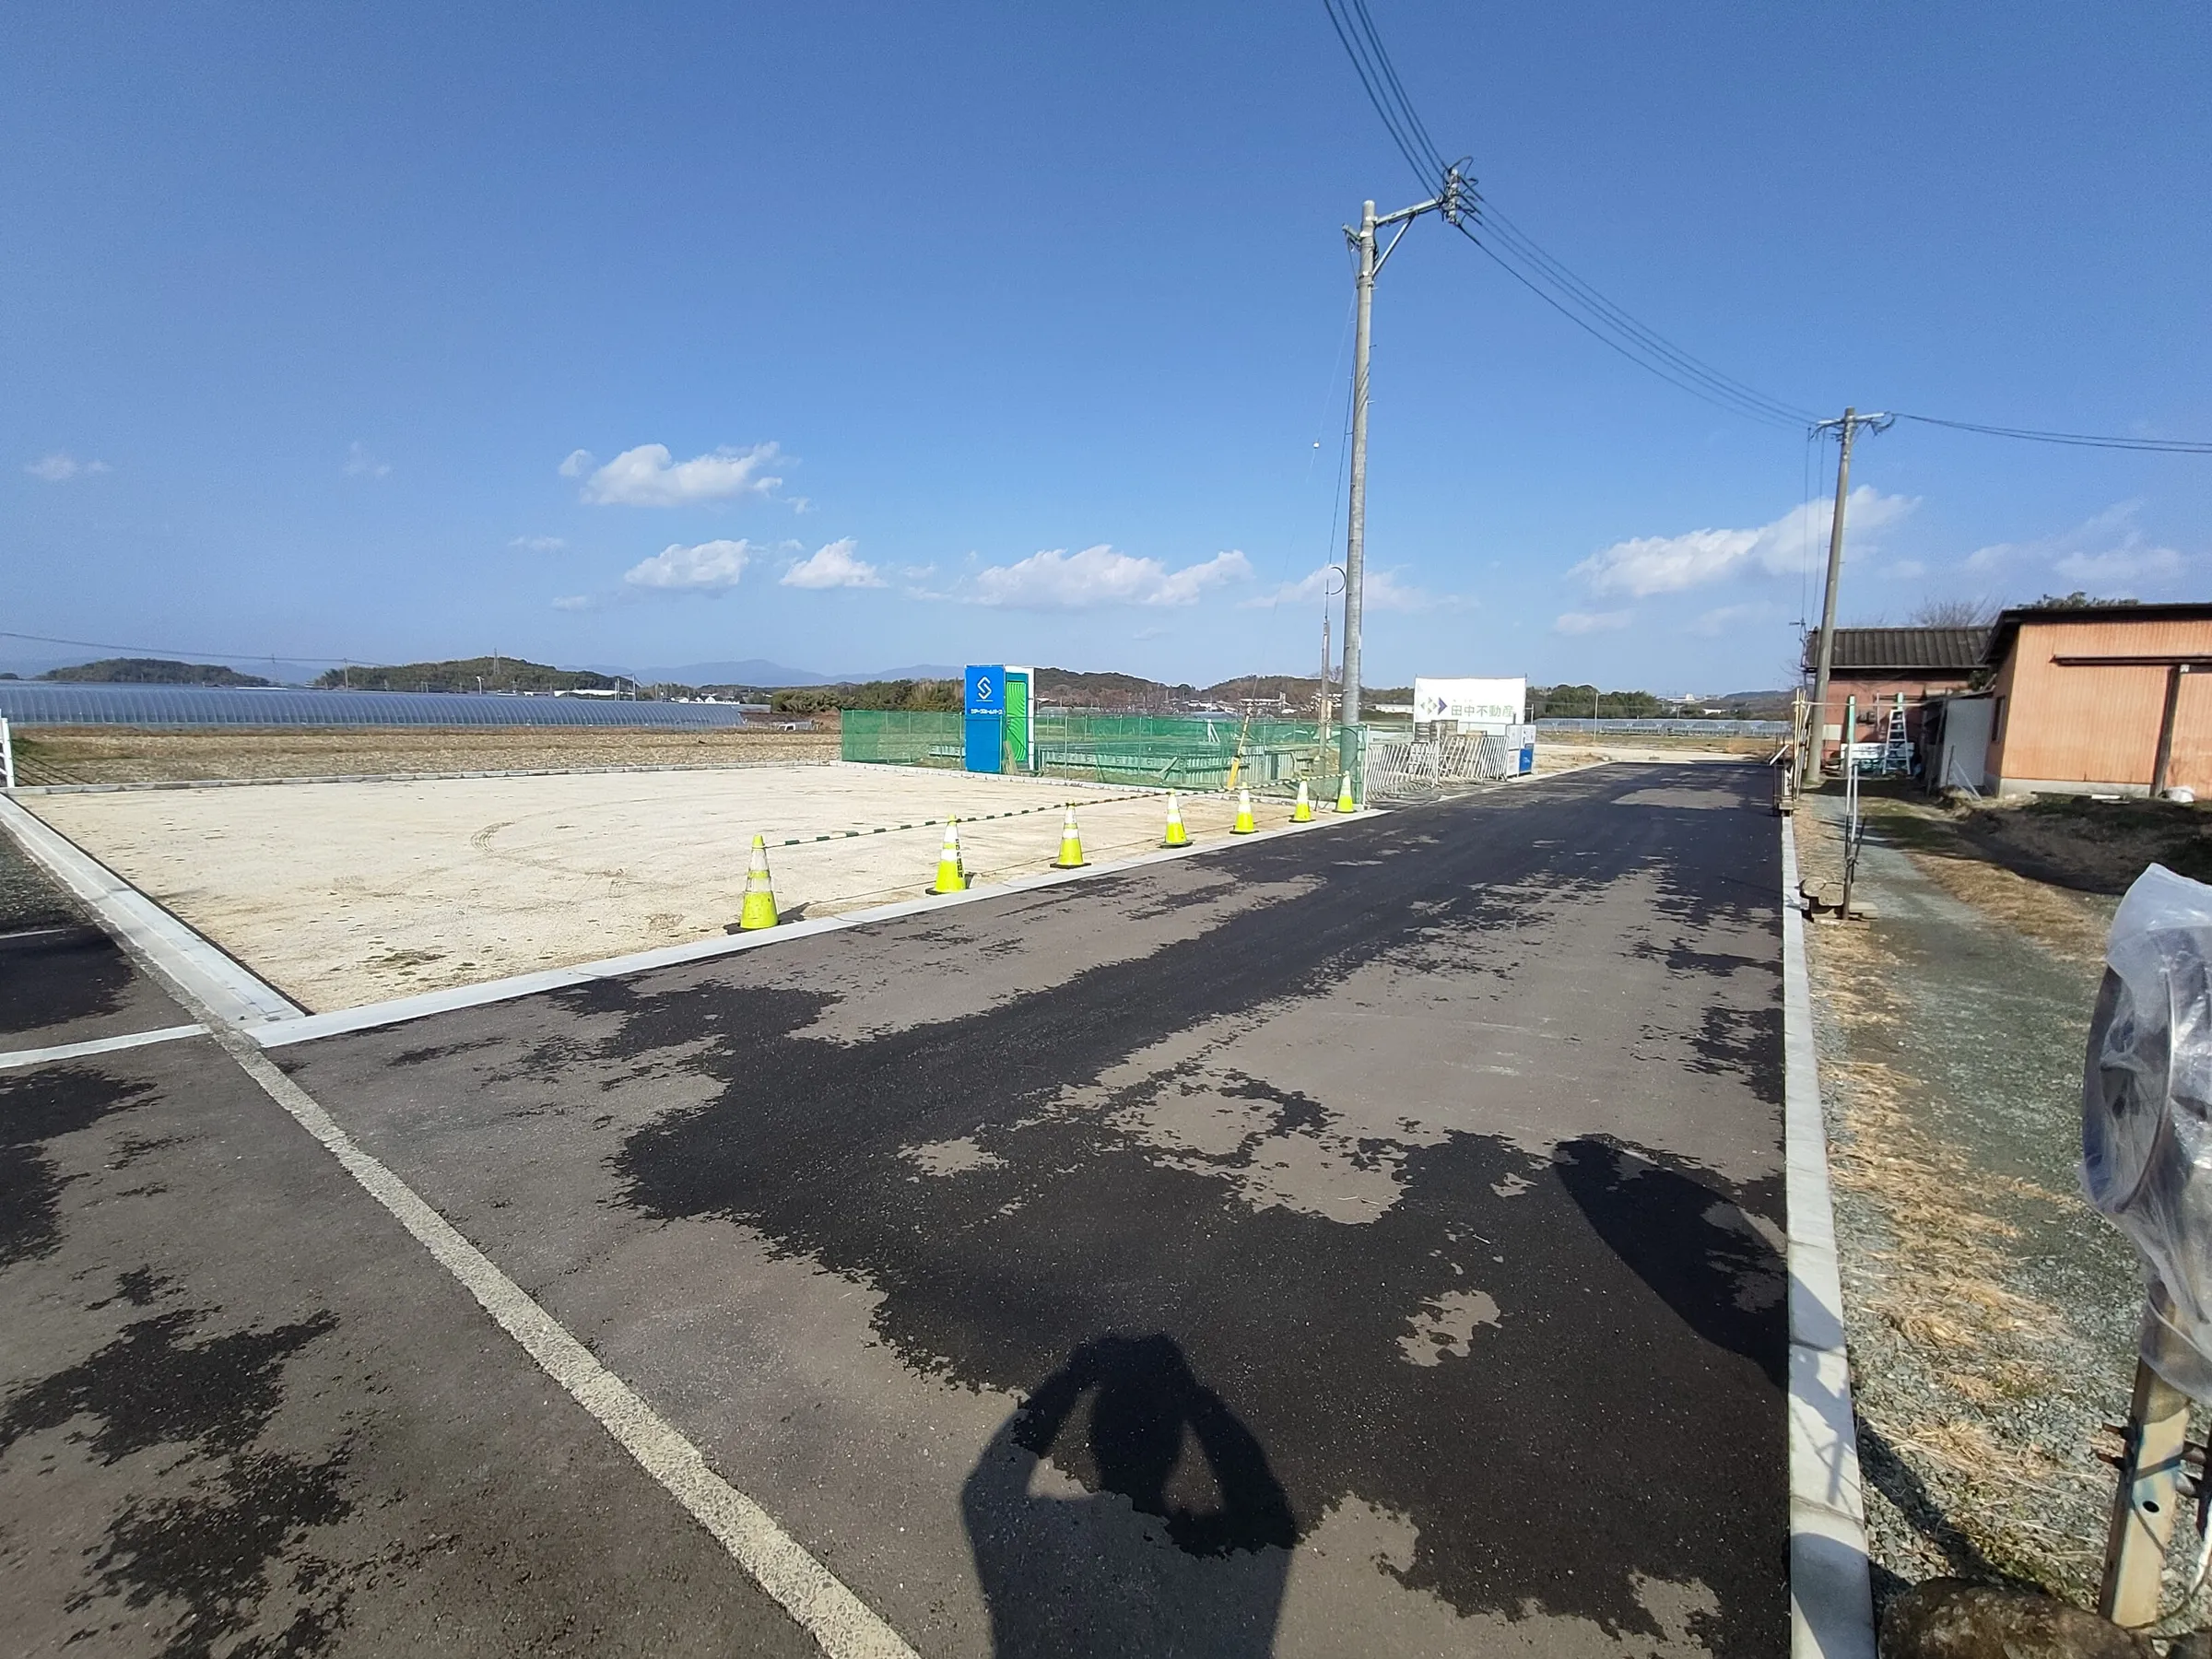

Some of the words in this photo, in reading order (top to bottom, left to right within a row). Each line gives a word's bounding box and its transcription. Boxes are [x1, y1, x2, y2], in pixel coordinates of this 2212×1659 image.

[1451, 704, 1513, 717] 田中不動産
